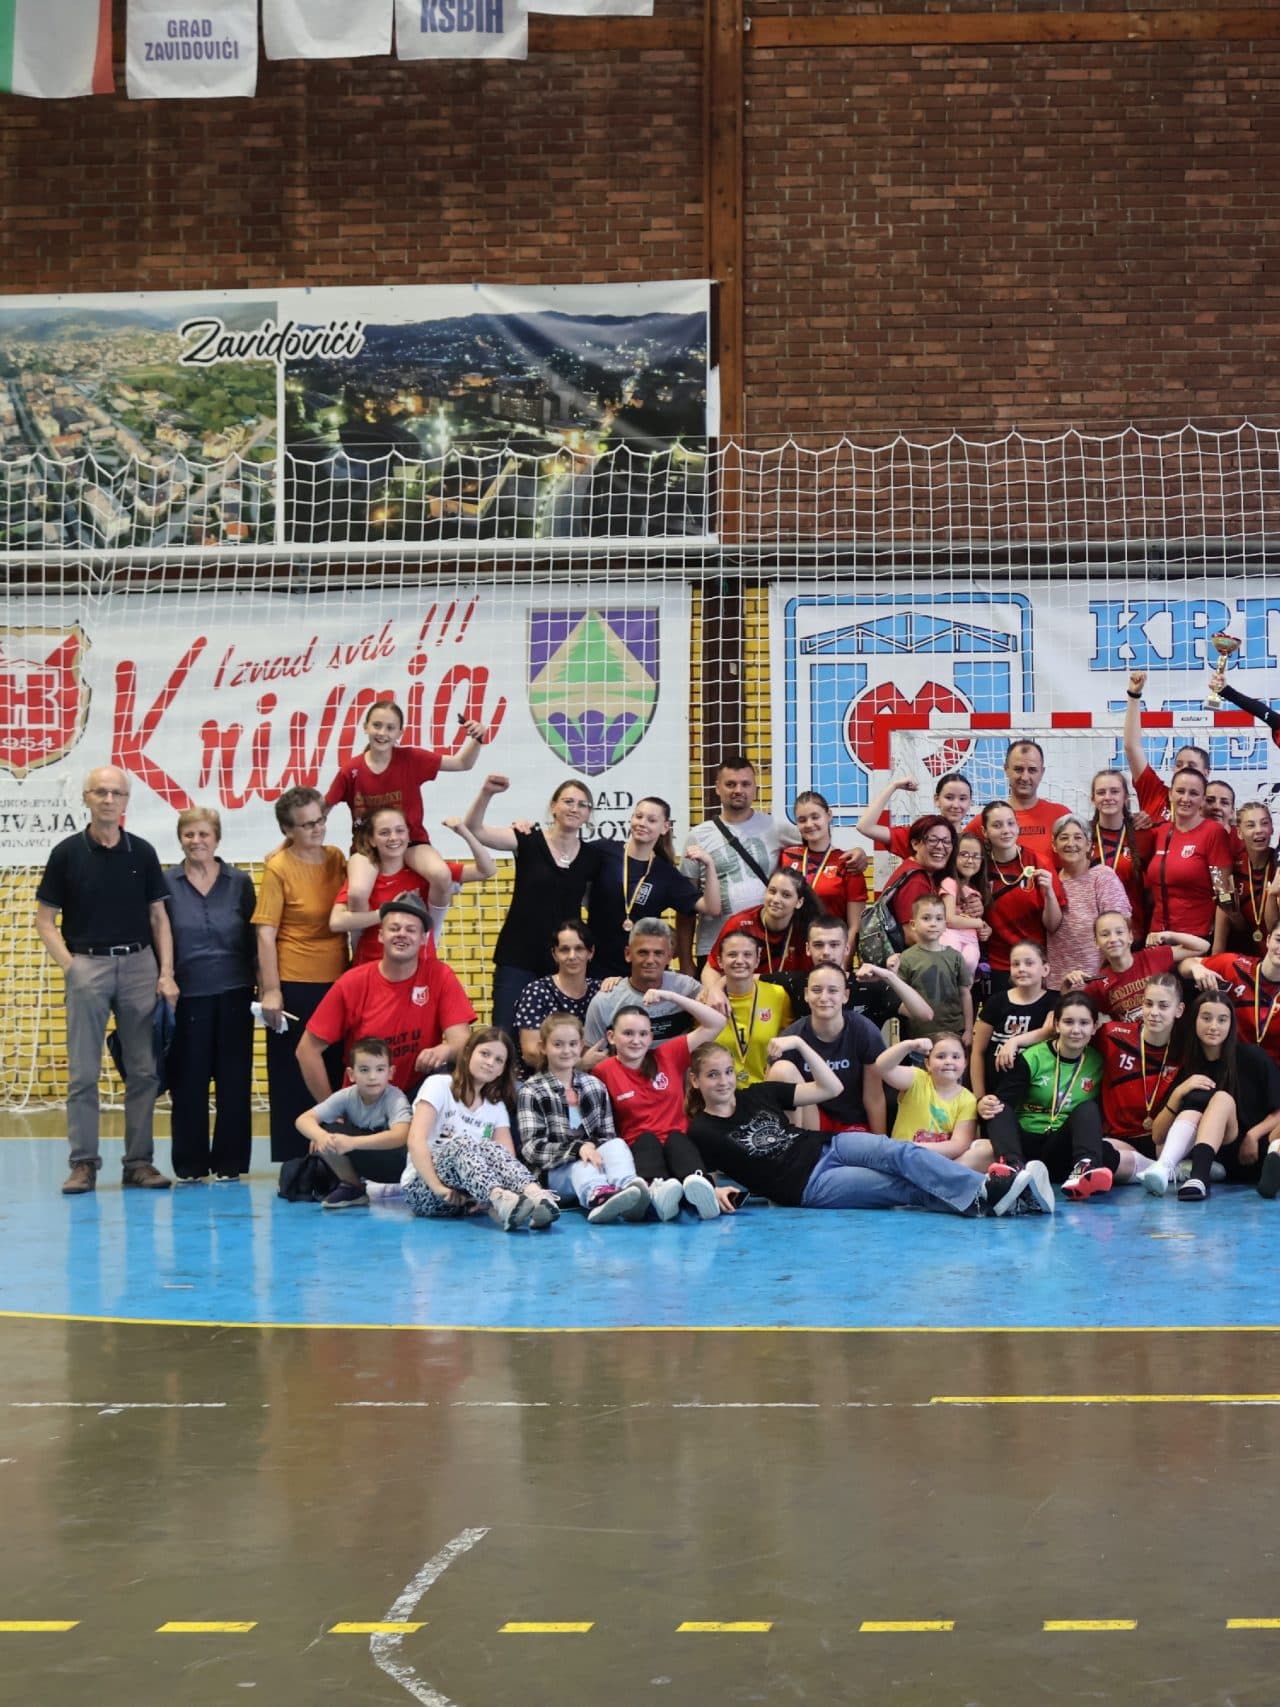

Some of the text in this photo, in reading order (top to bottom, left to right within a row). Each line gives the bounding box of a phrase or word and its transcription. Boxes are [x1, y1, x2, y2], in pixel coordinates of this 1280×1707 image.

[420, 0, 504, 33] KSBIH
[167, 20, 213, 38] GRAD
[144, 36, 240, 62] ZAVIDOVIĆI
[178, 318, 365, 366] Zavidovići
[0, 736, 56, 750] 954
[594, 791, 634, 809] AD
[0, 813, 78, 833] IVAJA
[1234, 984, 1247, 998] 4
[1118, 1053, 1136, 1071] 15
